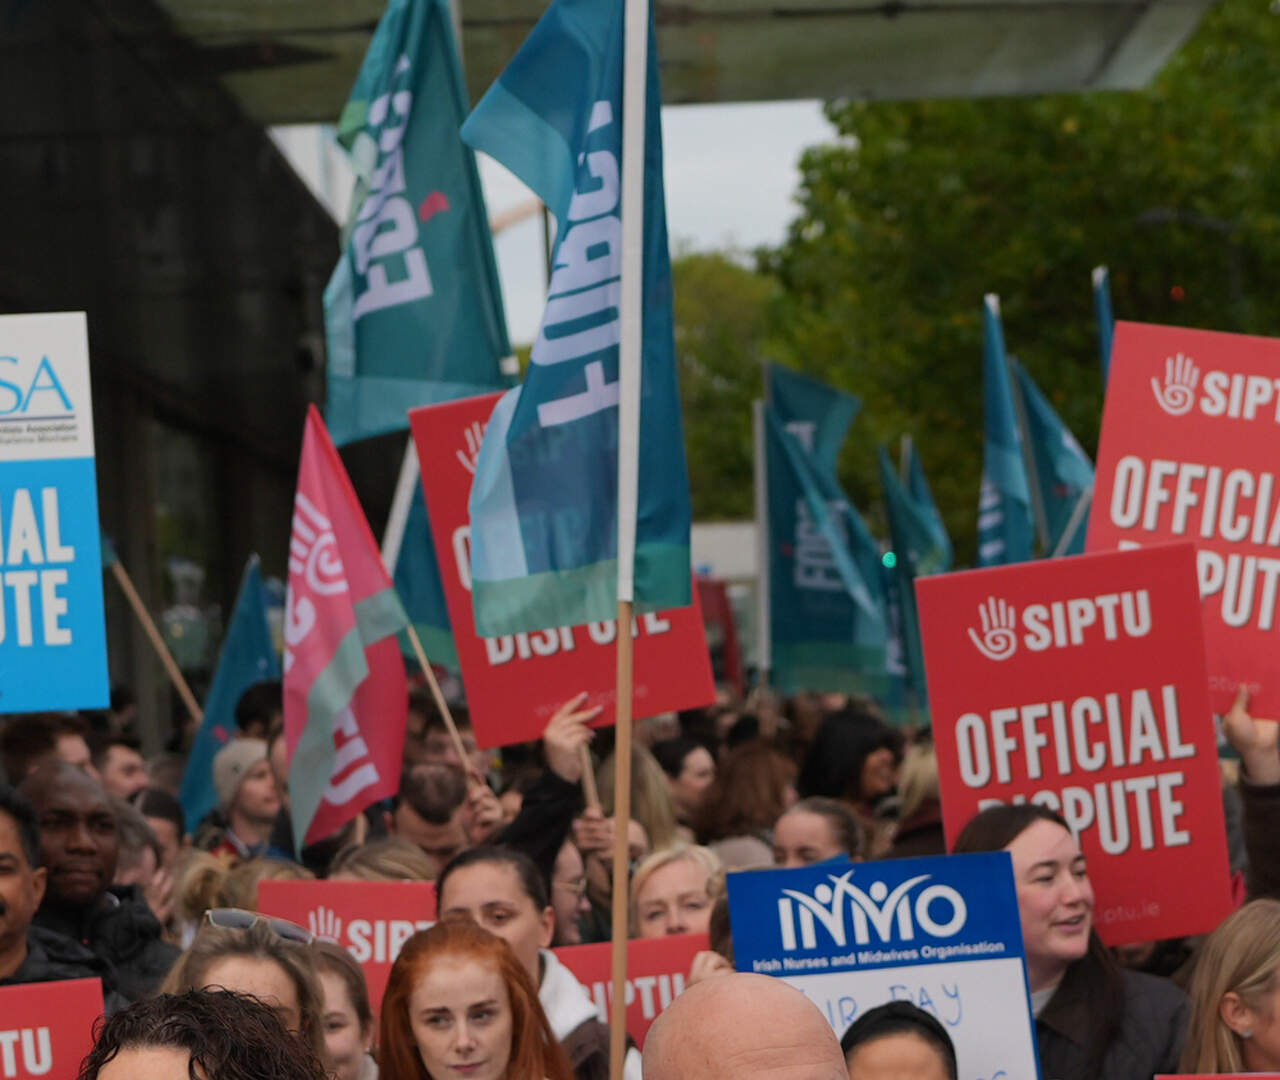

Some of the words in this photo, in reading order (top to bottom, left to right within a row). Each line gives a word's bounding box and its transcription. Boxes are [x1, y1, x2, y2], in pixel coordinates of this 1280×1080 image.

[1022, 590, 1153, 651] SIPTU
[955, 684, 1196, 789] OFFICIAL
[978, 771, 1192, 856] PUTE
[778, 869, 967, 951] INMO
[753, 959, 782, 972] Irish
[783, 956, 829, 970] Nurses
[831, 953, 856, 967] and
[858, 949, 918, 965] Midwives
[921, 941, 1006, 959] Organisation
